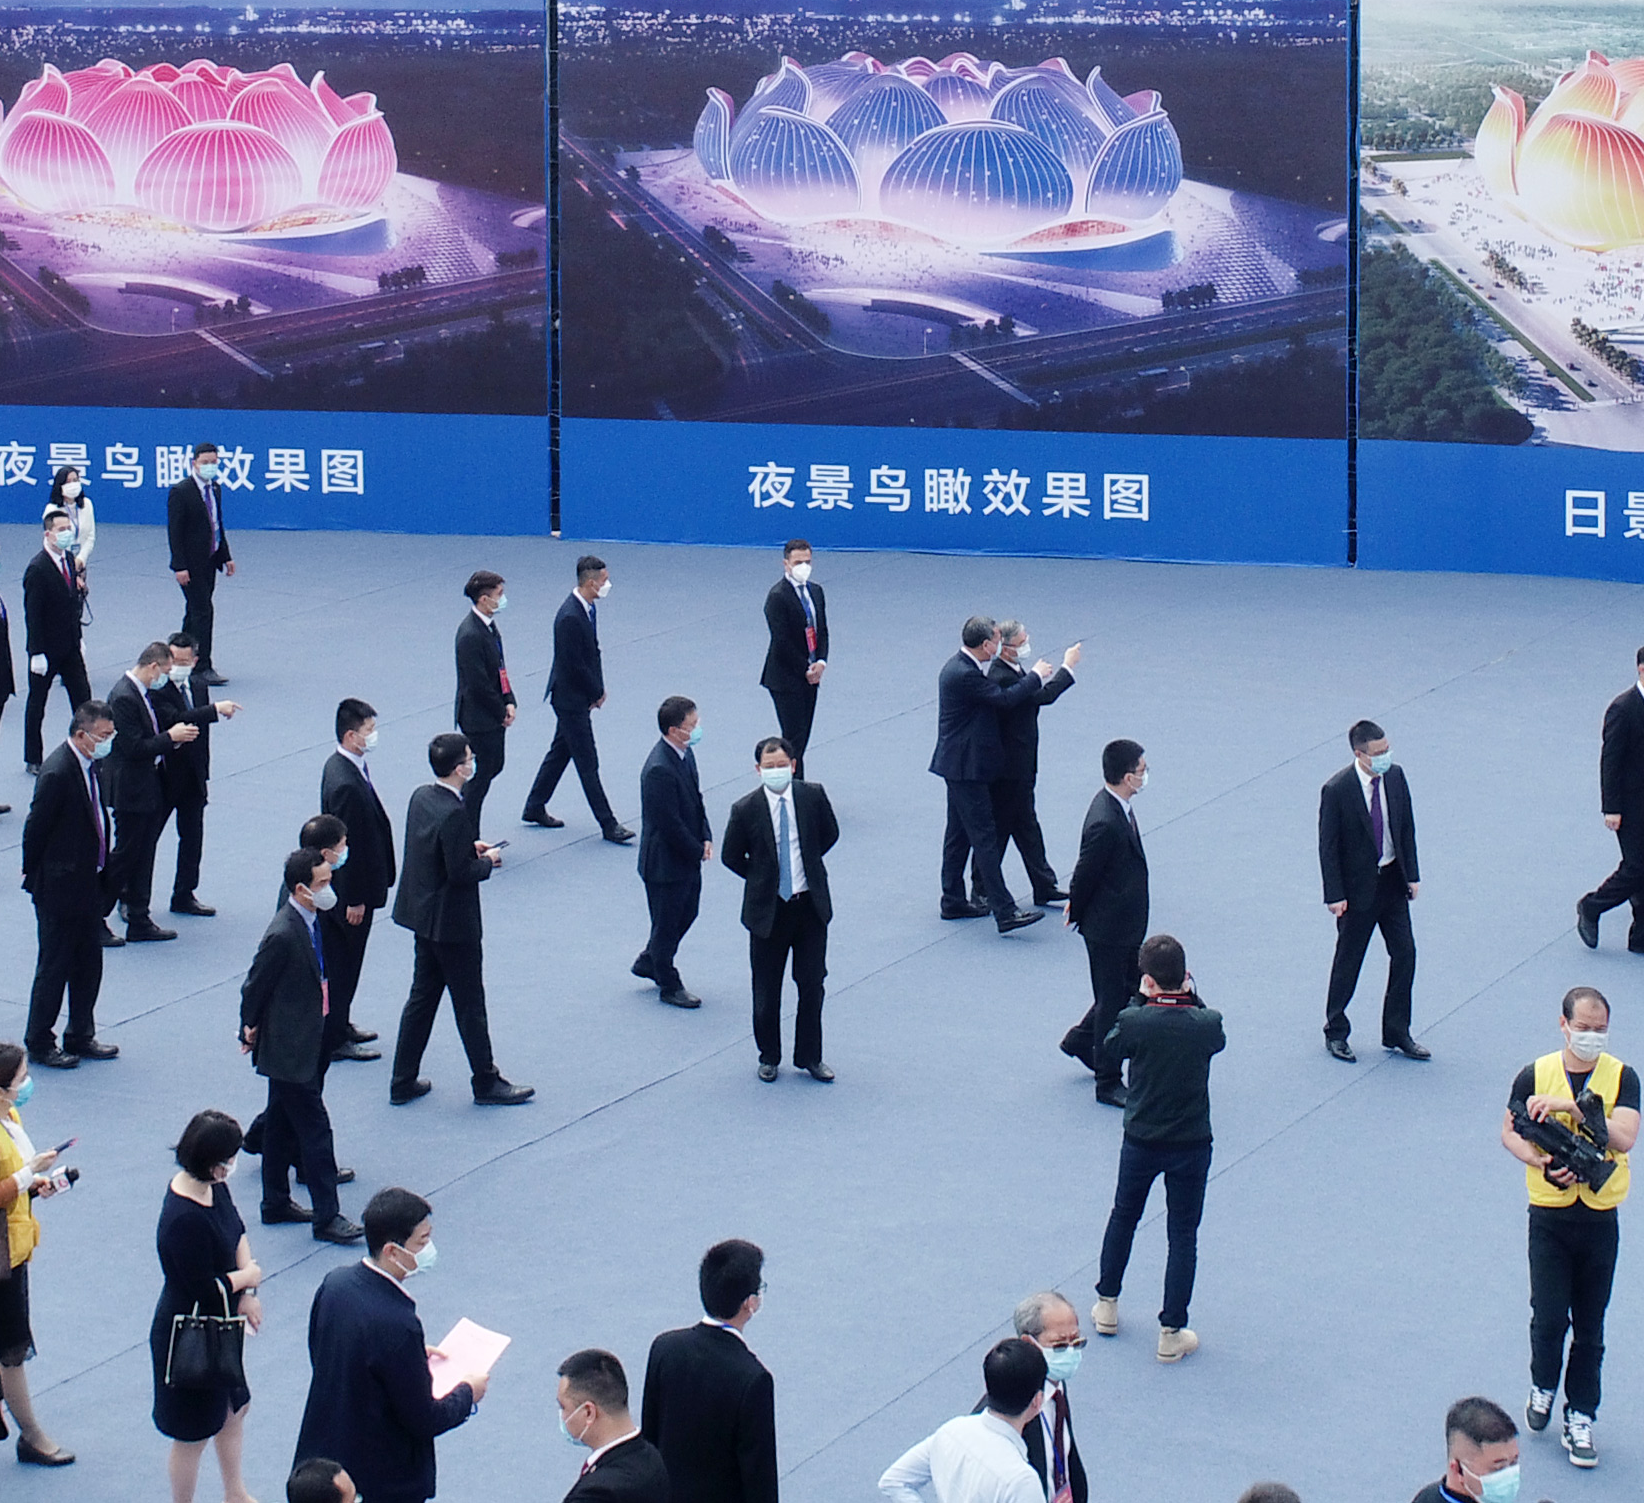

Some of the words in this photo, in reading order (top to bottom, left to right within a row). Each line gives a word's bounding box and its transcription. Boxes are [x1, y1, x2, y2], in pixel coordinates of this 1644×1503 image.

[748, 461, 1150, 521] 夜景鸟瞰效果图
